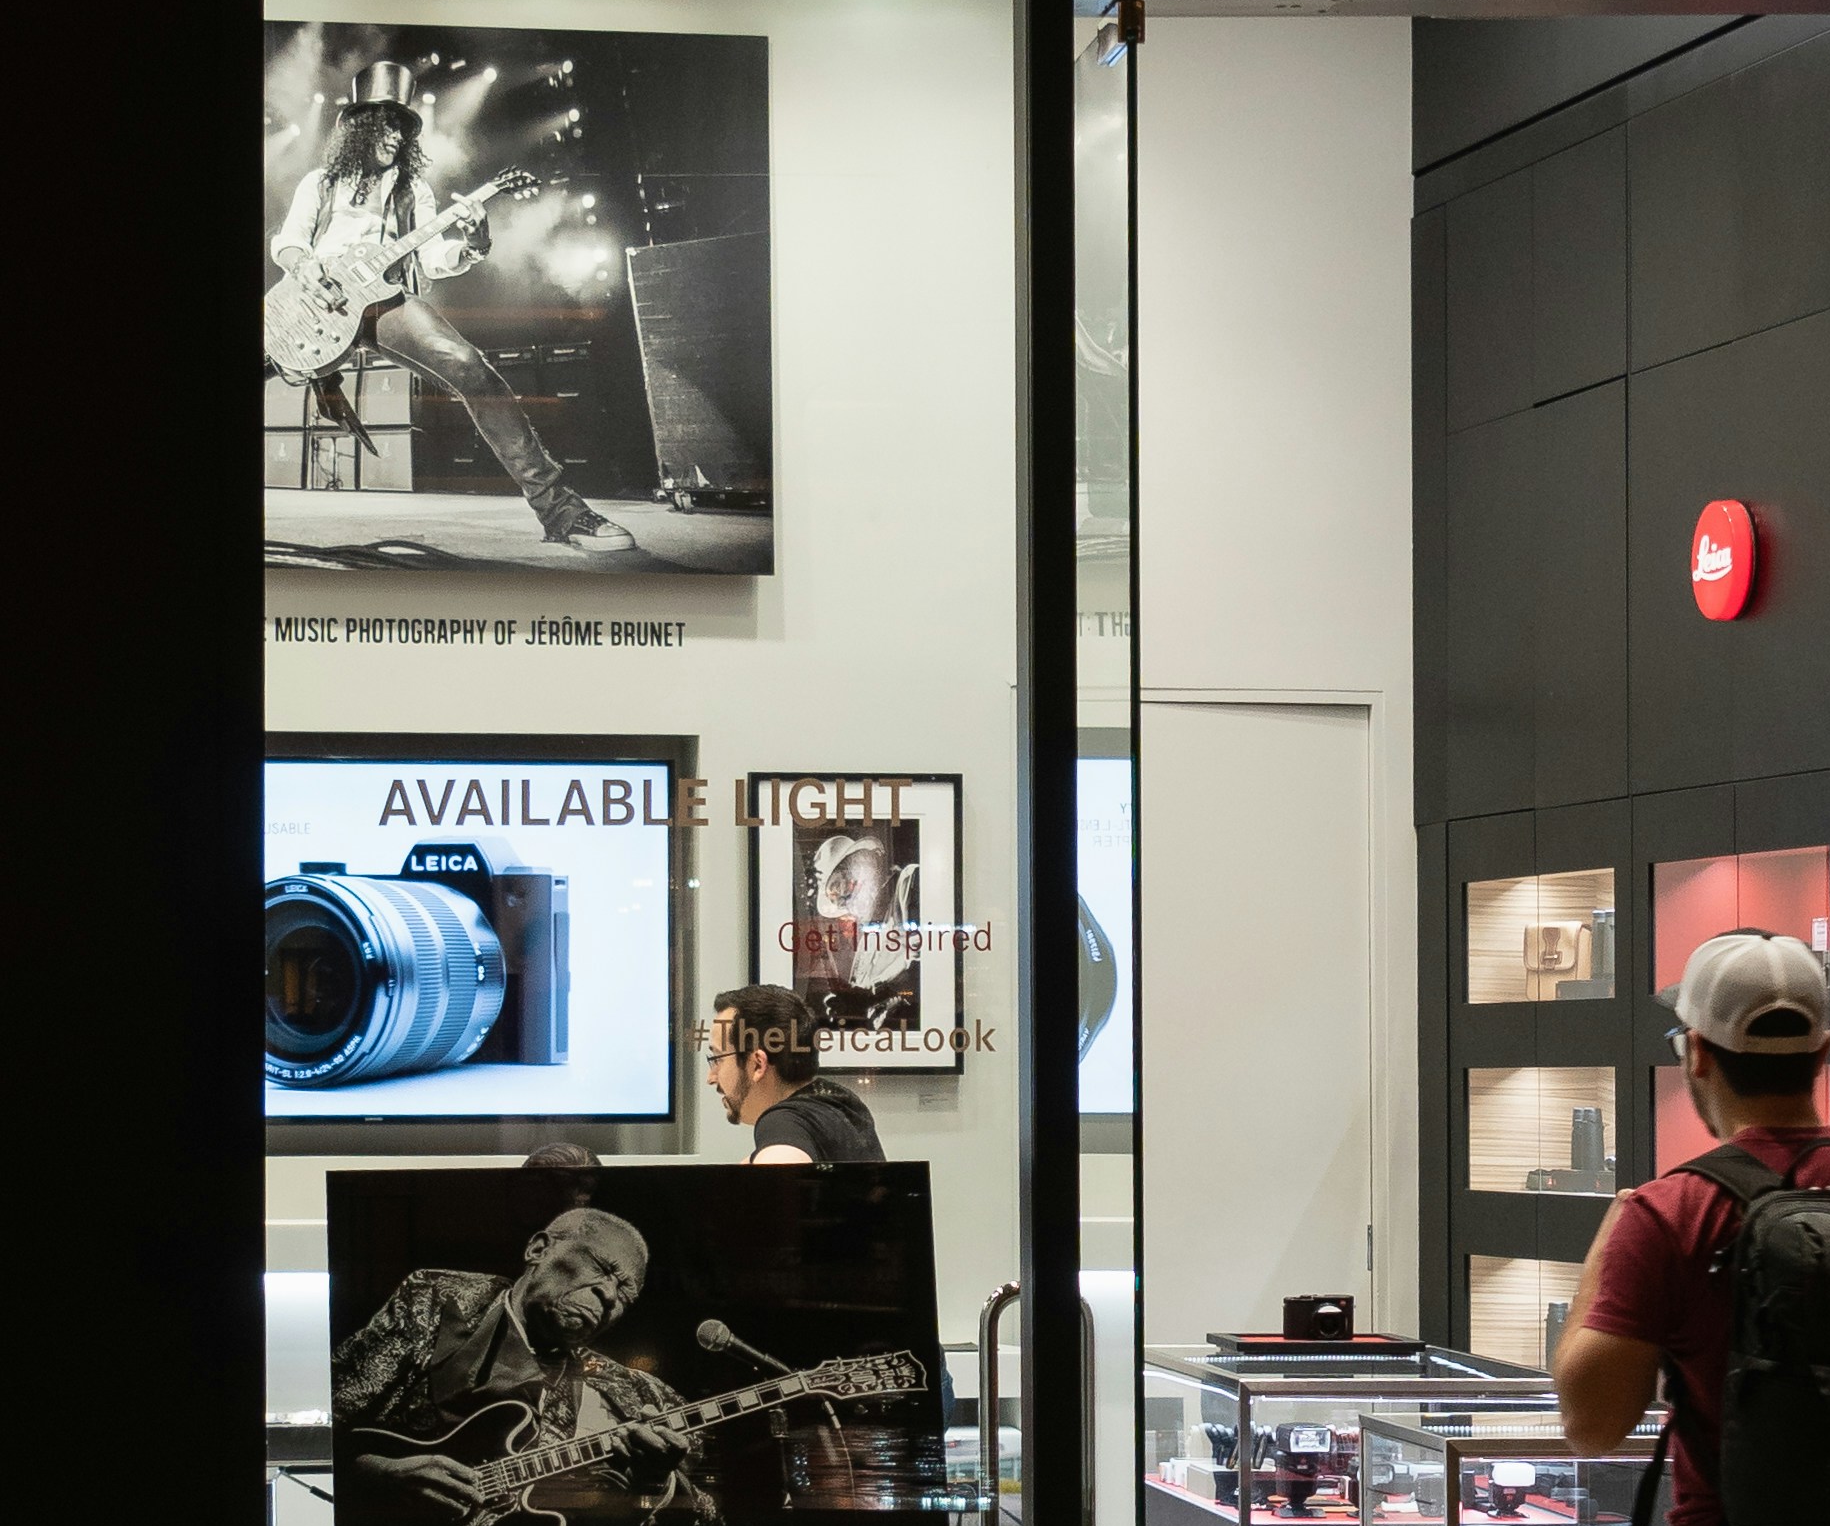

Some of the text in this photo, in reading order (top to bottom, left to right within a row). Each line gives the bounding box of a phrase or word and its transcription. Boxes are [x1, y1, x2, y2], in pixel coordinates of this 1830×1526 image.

[275, 615, 686, 647] MUSIC PHOTOGRAPHY OF JÉRÔME BRUNET
[379, 778, 913, 828] AVAILABLE LIGHT
[411, 855, 479, 873] LEICA
[778, 921, 993, 960] Get Inspired
[688, 1018, 997, 1053] #TheLeicaLook
